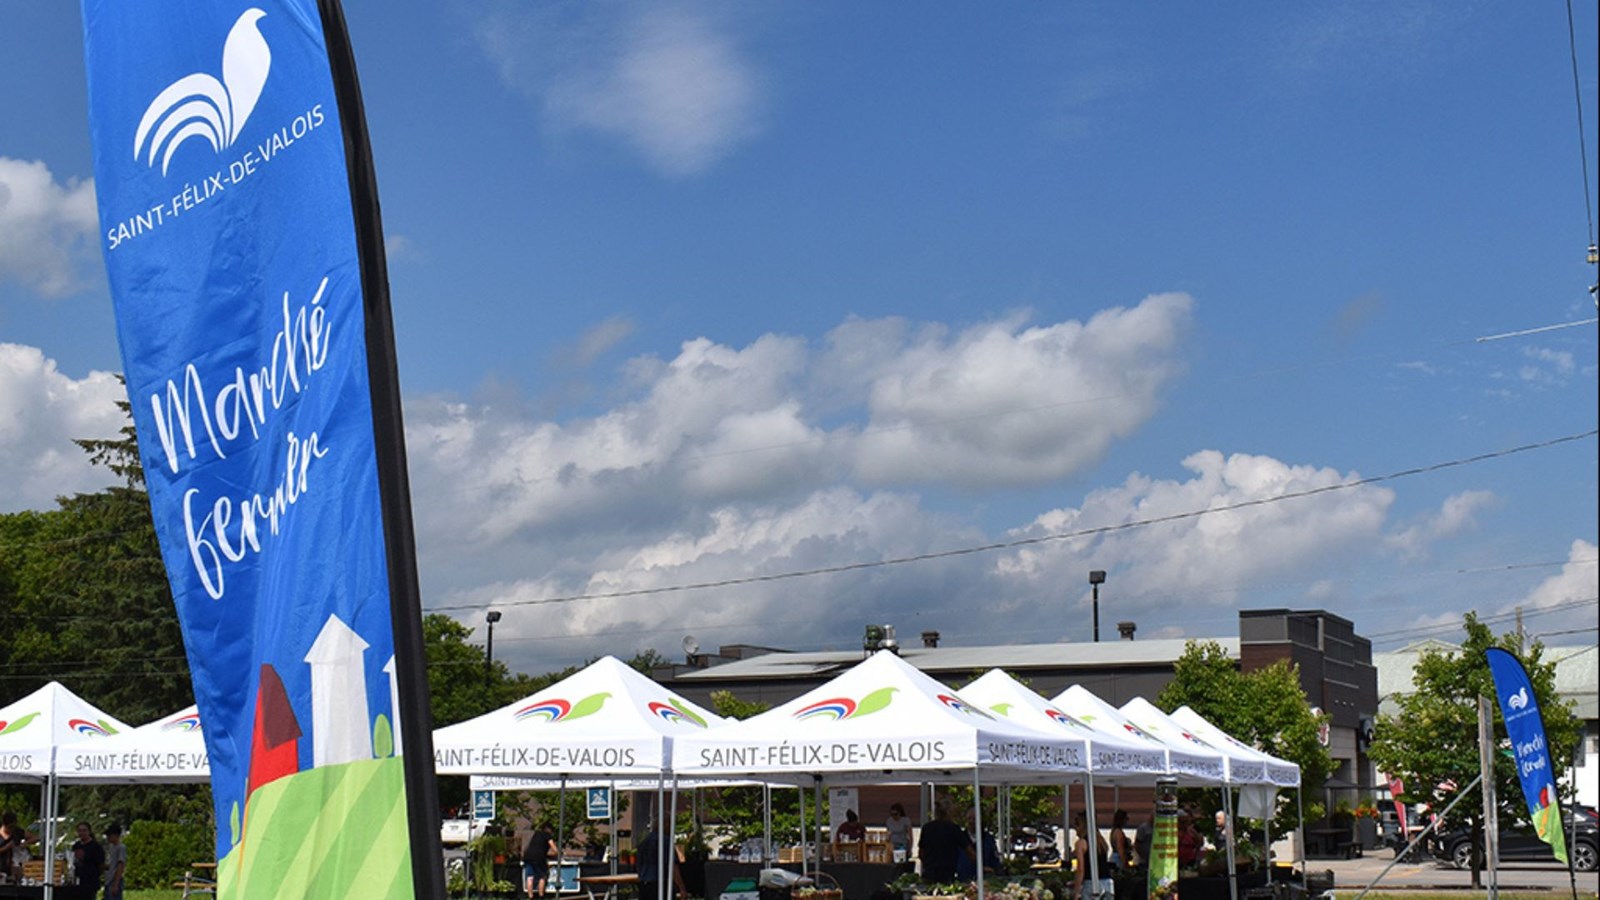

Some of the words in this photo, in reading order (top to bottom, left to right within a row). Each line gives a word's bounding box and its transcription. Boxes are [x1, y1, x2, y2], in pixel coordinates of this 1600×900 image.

[107, 104, 325, 250] SAINT-FÉLIX-DE-VALOIS
[151, 276, 331, 475] Marché
[700, 740, 945, 768] SAINT-FÉLIX-DE-VALOIS
